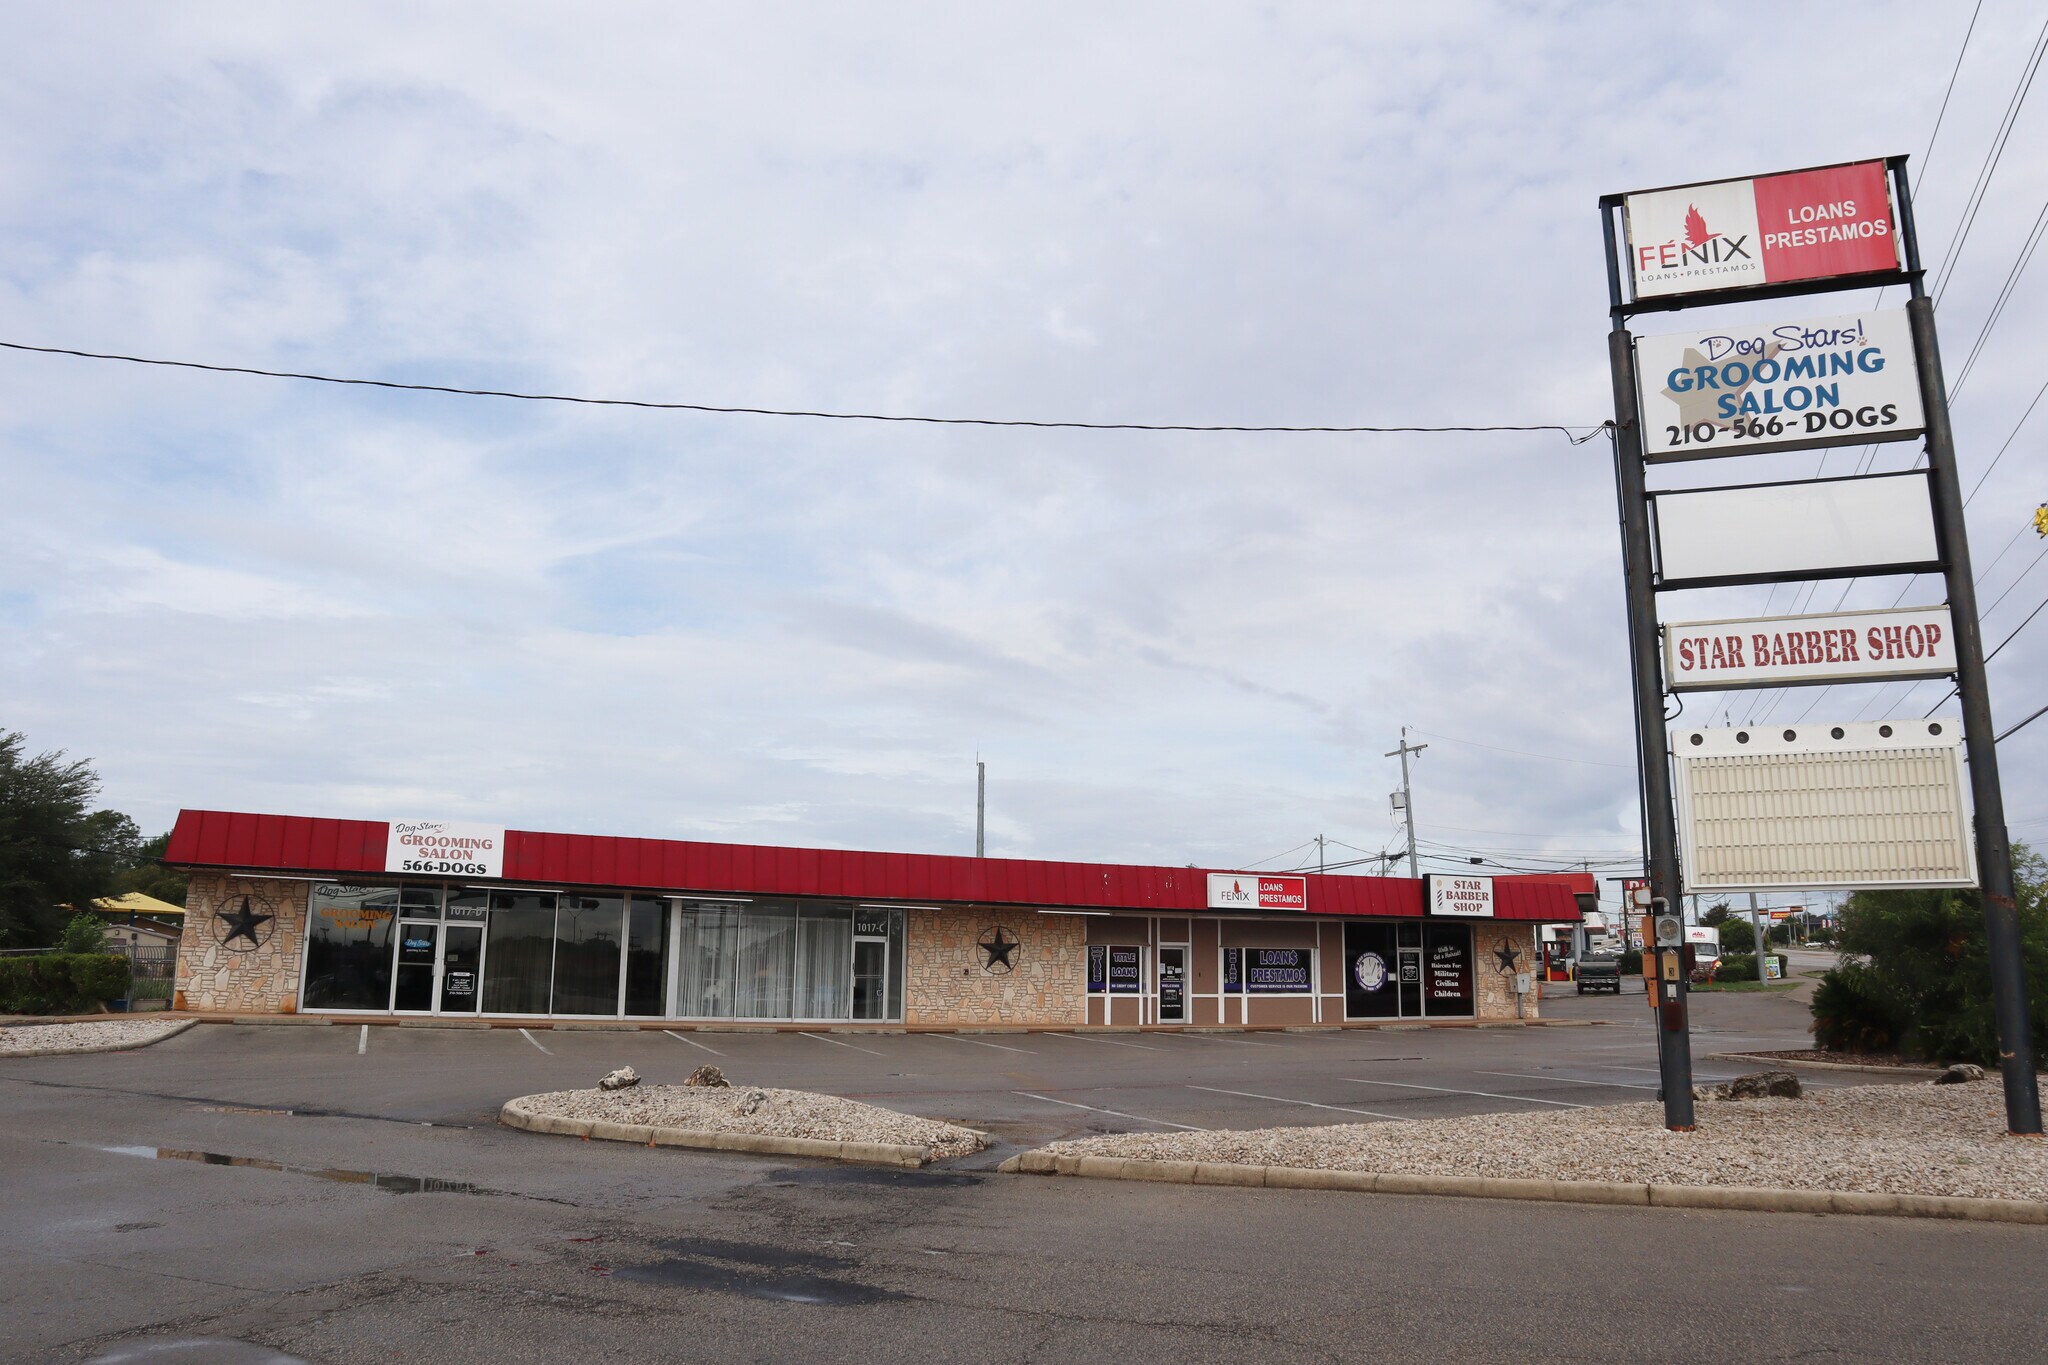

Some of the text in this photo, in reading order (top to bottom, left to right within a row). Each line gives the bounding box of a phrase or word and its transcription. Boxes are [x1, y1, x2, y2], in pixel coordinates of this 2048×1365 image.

[1788, 200, 1857, 225] LOANS
[1764, 219, 1888, 250] PRESTAMOS
[1639, 235, 1752, 271] FÉNIX
[1641, 263, 1756, 282] LOANS PRESTAMOS
[1699, 318, 1867, 361] Dog Stars!
[1667, 347, 1886, 393] GROOMING
[1717, 382, 1840, 419] SALON
[1666, 404, 1898, 446] 210-566-DOGS
[1679, 623, 1942, 671] STAR BARBER SHOP
[395, 823, 416, 836] Dog
[400, 835, 493, 850] GROOMING
[418, 847, 474, 860] SALON
[402, 860, 487, 874] 566-DOGS
[1260, 883, 1284, 892] LOANS
[1453, 880, 1481, 890] STAR
[1260, 894, 1302, 904] PRESTAMOS
[1446, 890, 1490, 901] BARBER
[320, 907, 393, 920] GROOMING
[1453, 902, 1483, 912] SHOP
[335, 918, 377, 929] SALON
[857, 922, 885, 933] 1017-C
[1113, 953, 1136, 963] TITLE
[1259, 950, 1298, 966] LOAN$
[1251, 967, 1307, 983] PRESTAMO$
[1434, 970, 1459, 978] Military
[1435, 979, 1459, 987] Civilian
